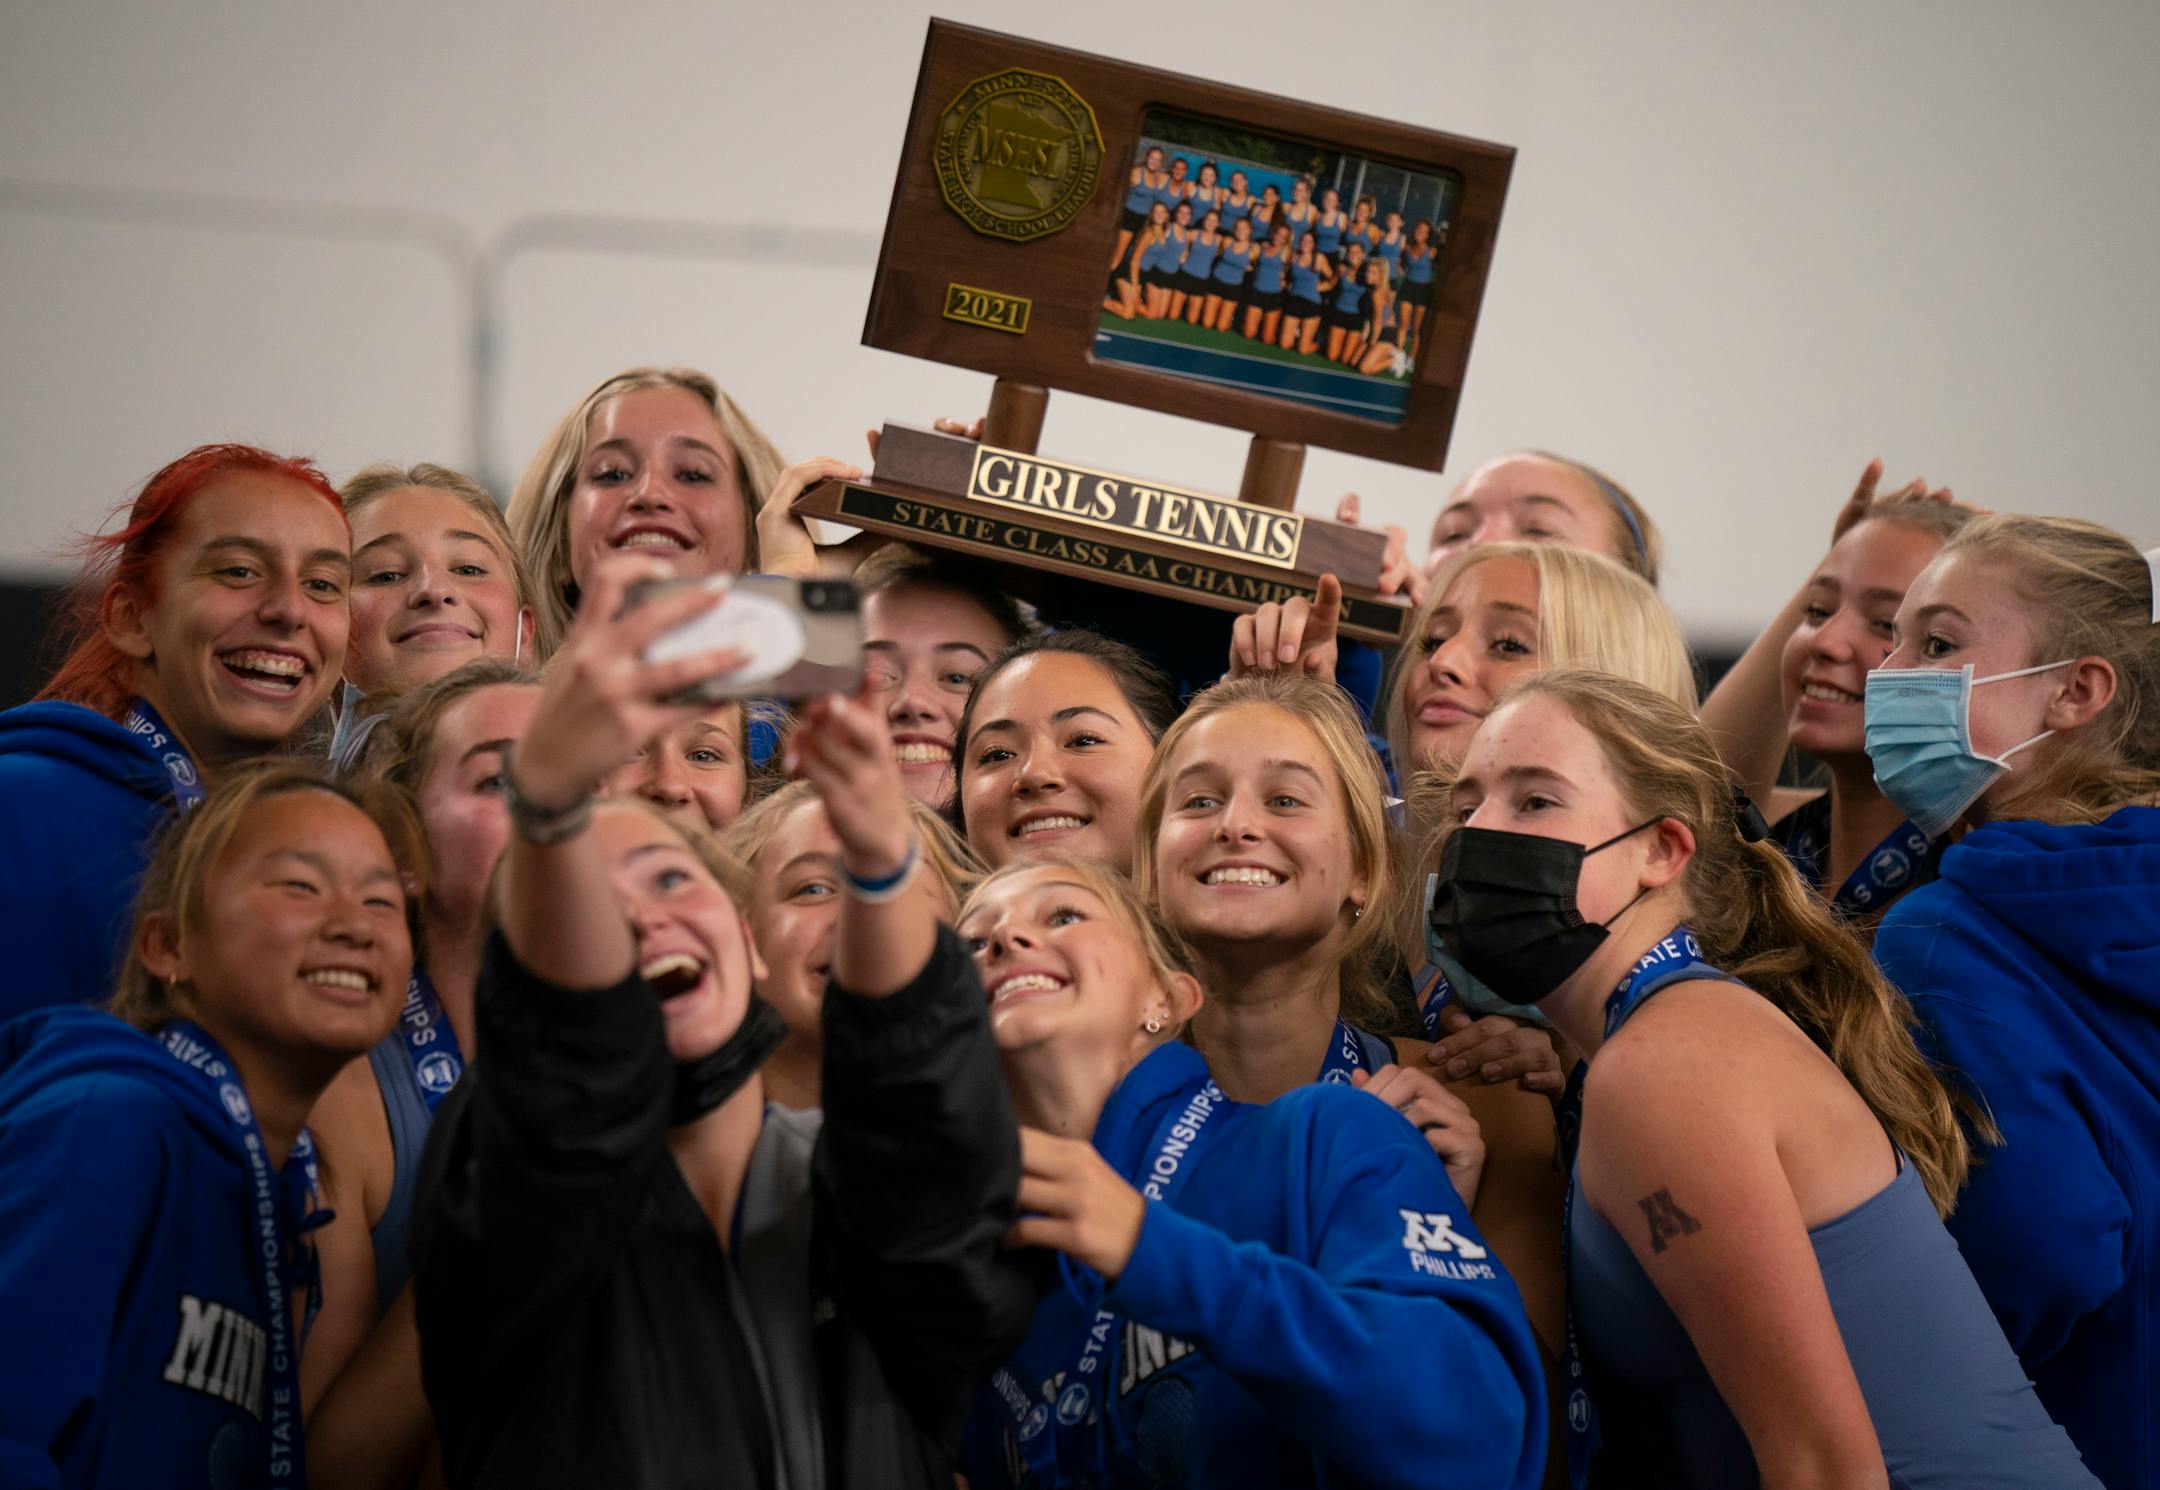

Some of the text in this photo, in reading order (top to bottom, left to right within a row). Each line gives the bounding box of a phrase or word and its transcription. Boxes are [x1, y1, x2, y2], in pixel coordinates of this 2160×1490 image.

[973, 74, 1085, 119] MINNESOTA
[954, 291, 1022, 327] 2021
[893, 502, 996, 542] STATE
[1004, 527, 1108, 567] CLASS
[1115, 553, 1161, 580] AA
[978, 455, 1296, 559] GIRLS TENNIS
[243, 1132, 292, 1477] STATE CHAMPIONSHIPS
